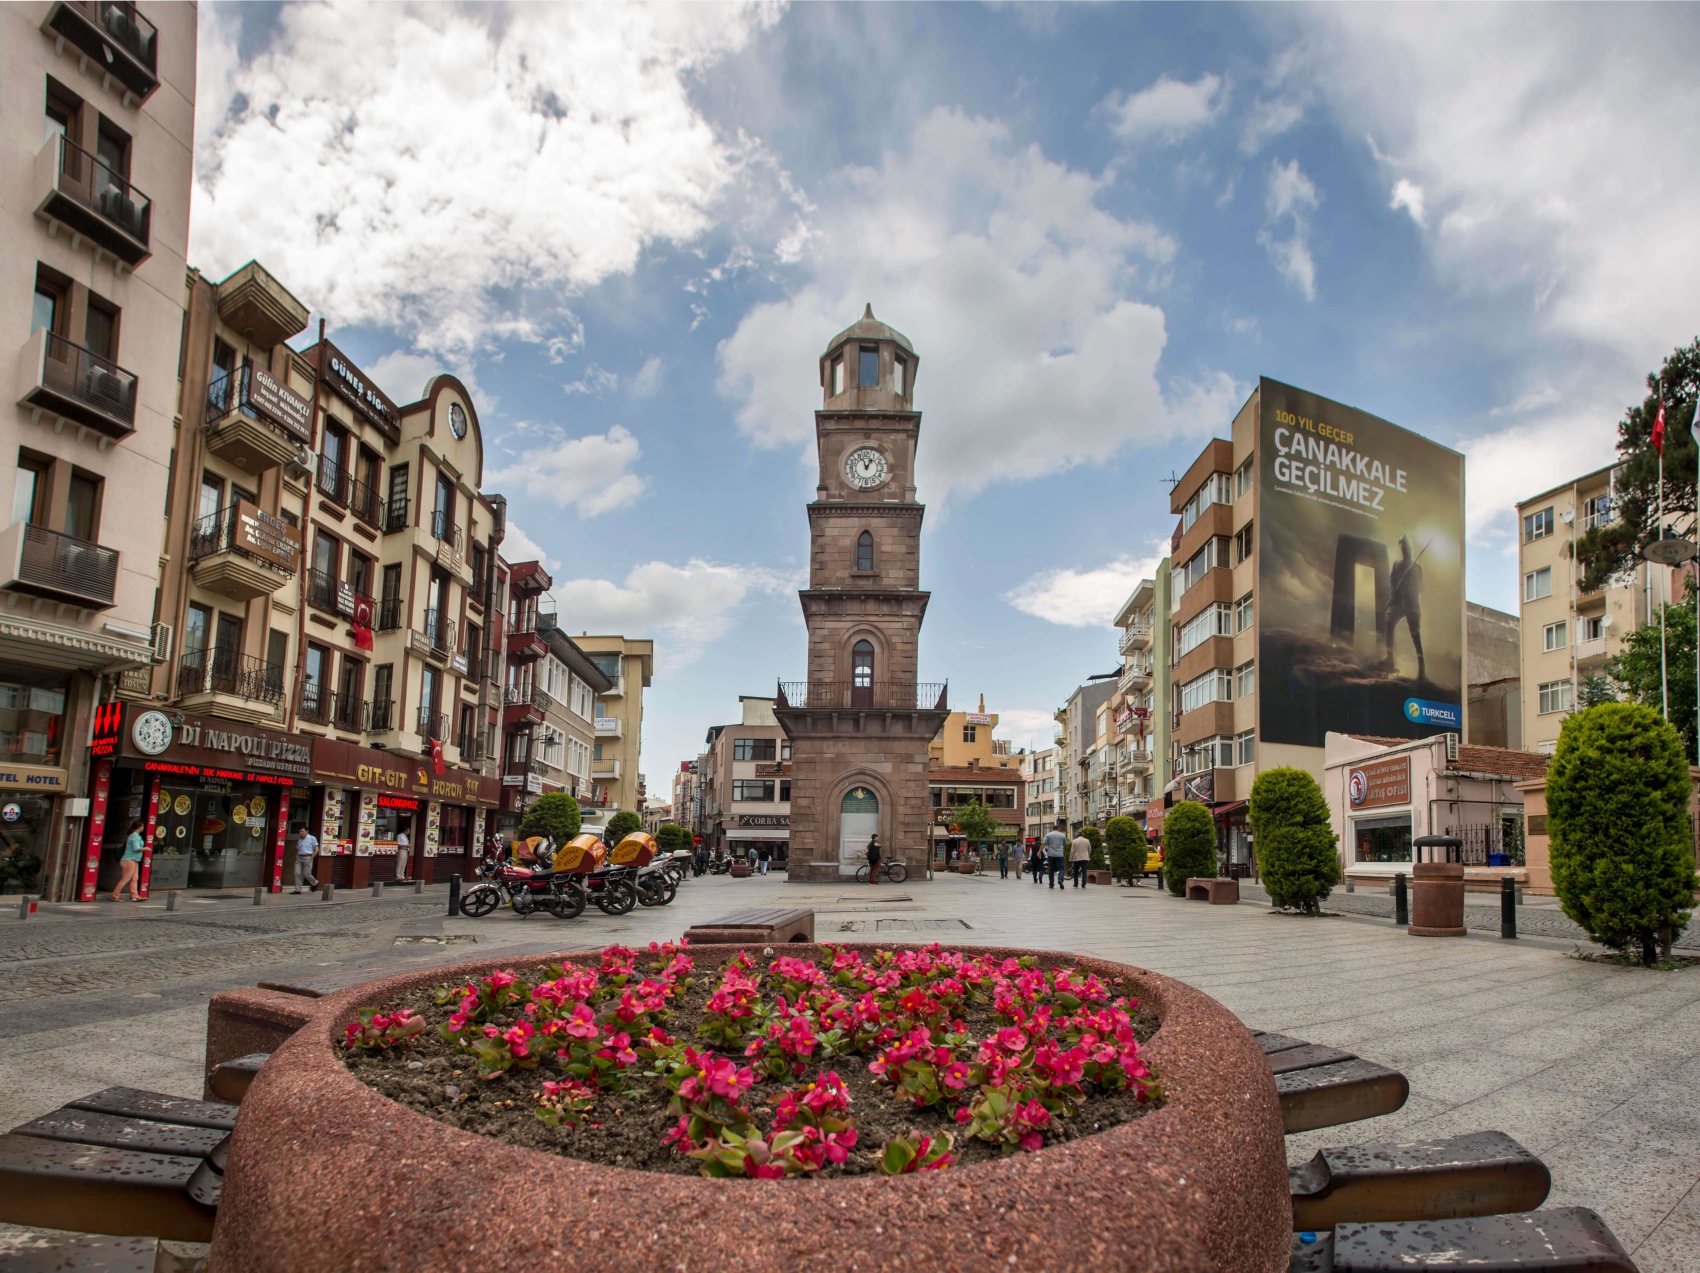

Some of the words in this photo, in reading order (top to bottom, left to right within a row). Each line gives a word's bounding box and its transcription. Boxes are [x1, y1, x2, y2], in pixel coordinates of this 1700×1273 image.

[331, 357, 364, 396] GÜNEŞ
[256, 371, 278, 393] Gülin
[278, 388, 310, 416] KIVANÇLI
[1275, 410, 1296, 426] 100
[1298, 415, 1316, 433] YIL
[1318, 422, 1354, 446] GEÇER
[1274, 427, 1408, 493] ÇANAKKALE
[1274, 457, 1385, 511] GEÇİLMEZ
[257, 509, 286, 535] ERDEŞ
[272, 546, 291, 562] ERDEŞ
[276, 540, 294, 556] ERDEŞ
[1421, 707, 1456, 720] TURKCELL
[179, 722, 201, 746] Dİ
[205, 729, 266, 756] NAPOLİ
[270, 738, 311, 763] PİZZA
[203, 768, 214, 777] TEK
[216, 769, 243, 780] MARKASI
[293, 765, 311, 774] ELLER
[26, 775, 61, 785] HOTEL
[1367, 787, 1386, 800] SATIŞ
[1386, 784, 1407, 797] OFİSİ
[378, 796, 418, 810] SALONUMUZ
[750, 817, 777, 826] ÇORBA
